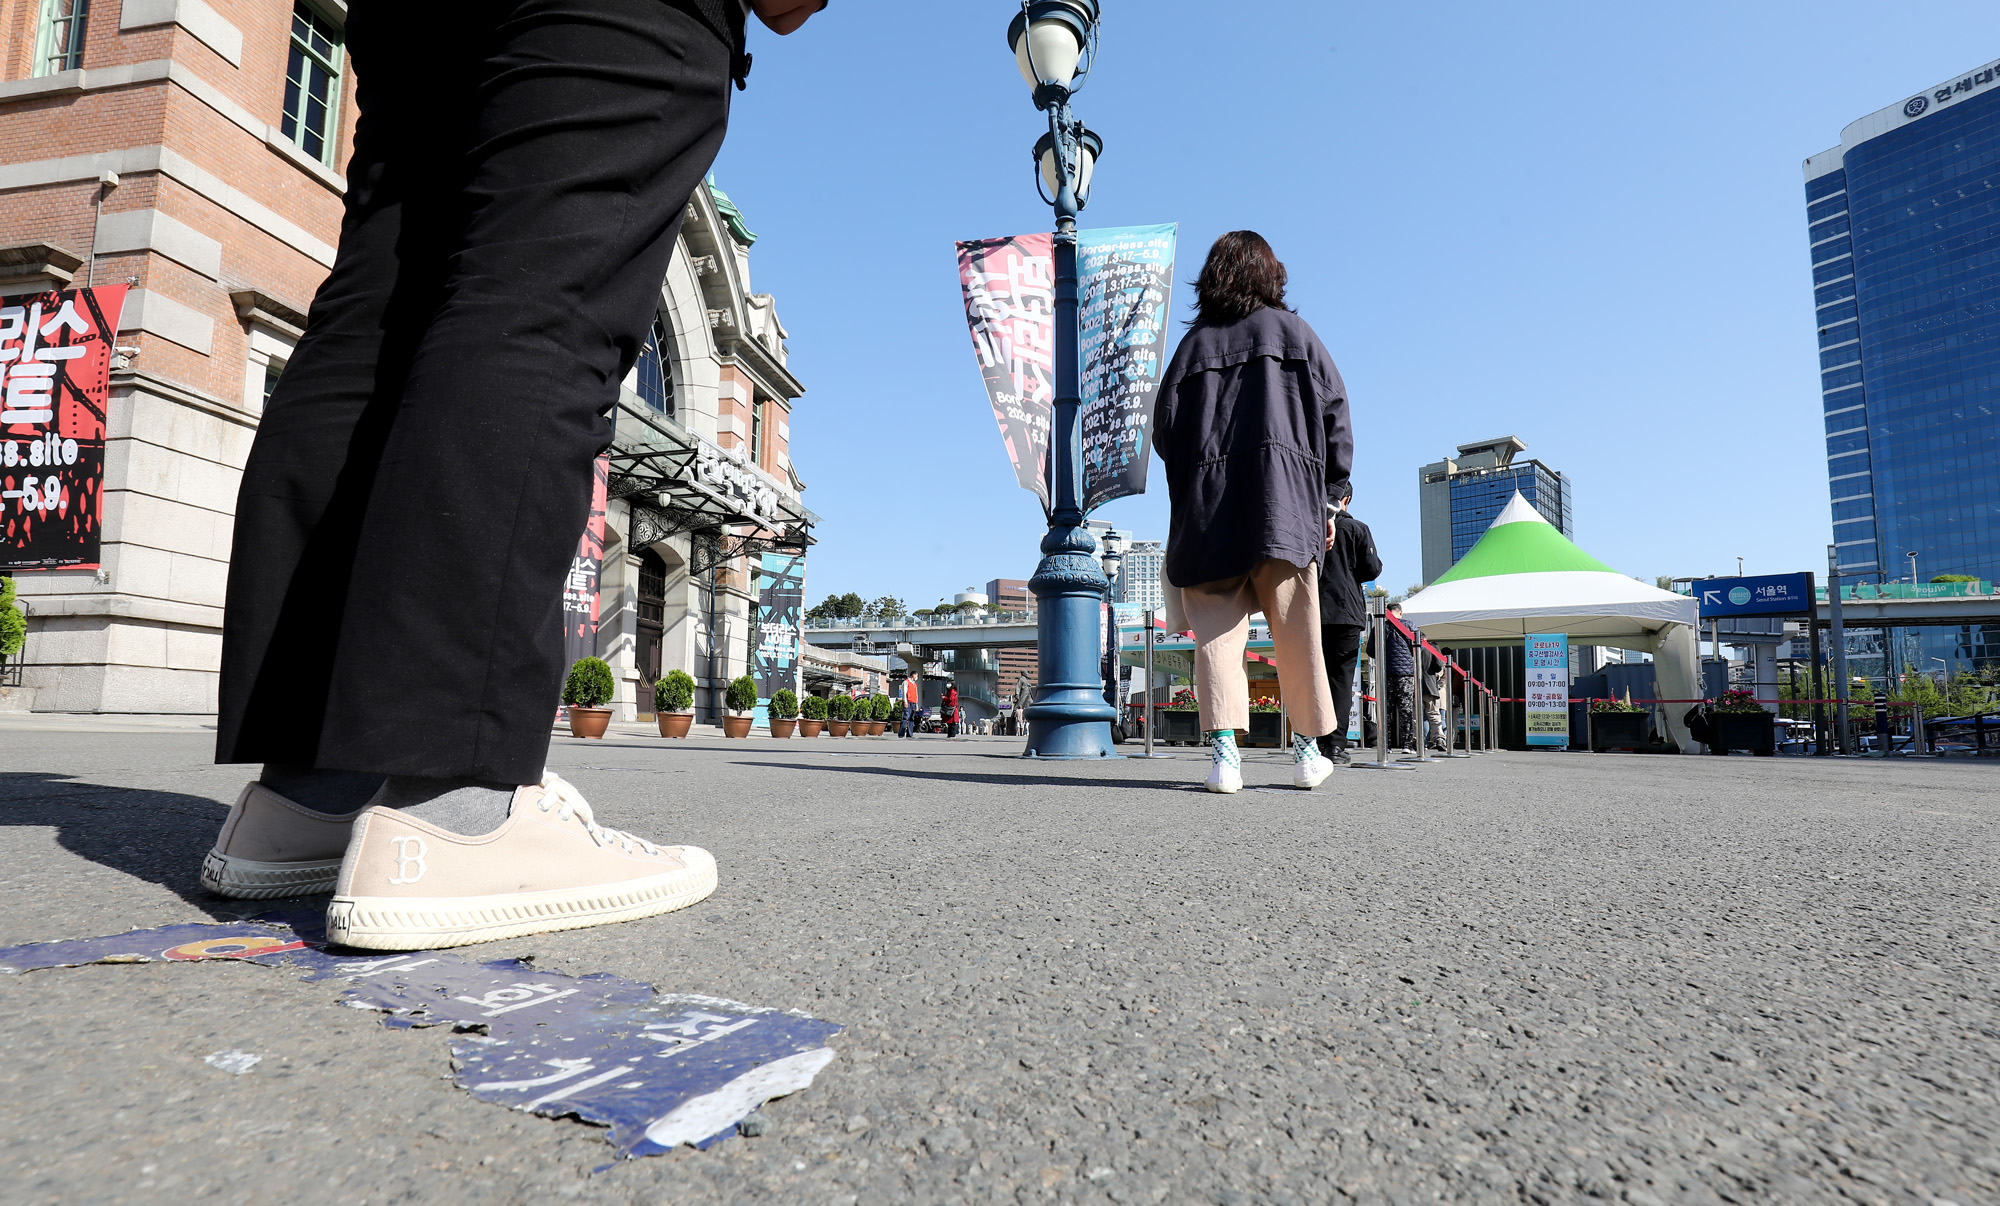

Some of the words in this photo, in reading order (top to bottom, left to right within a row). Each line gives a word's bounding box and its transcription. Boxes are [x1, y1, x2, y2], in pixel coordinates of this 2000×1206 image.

[1080, 238, 1169, 258] Border-less.site
[1080, 262, 1166, 288] Border-less.site
[1008, 254, 1052, 403] 보더리스
[0, 363, 57, 423] 트
[0, 431, 78, 467] s.site
[1756, 585, 1787, 597] 서울역
[760, 621, 797, 636] 보더리스
[764, 632, 792, 646] 사이트
[1533, 641, 1560, 649] 코로나19
[388, 835, 429, 885] B
